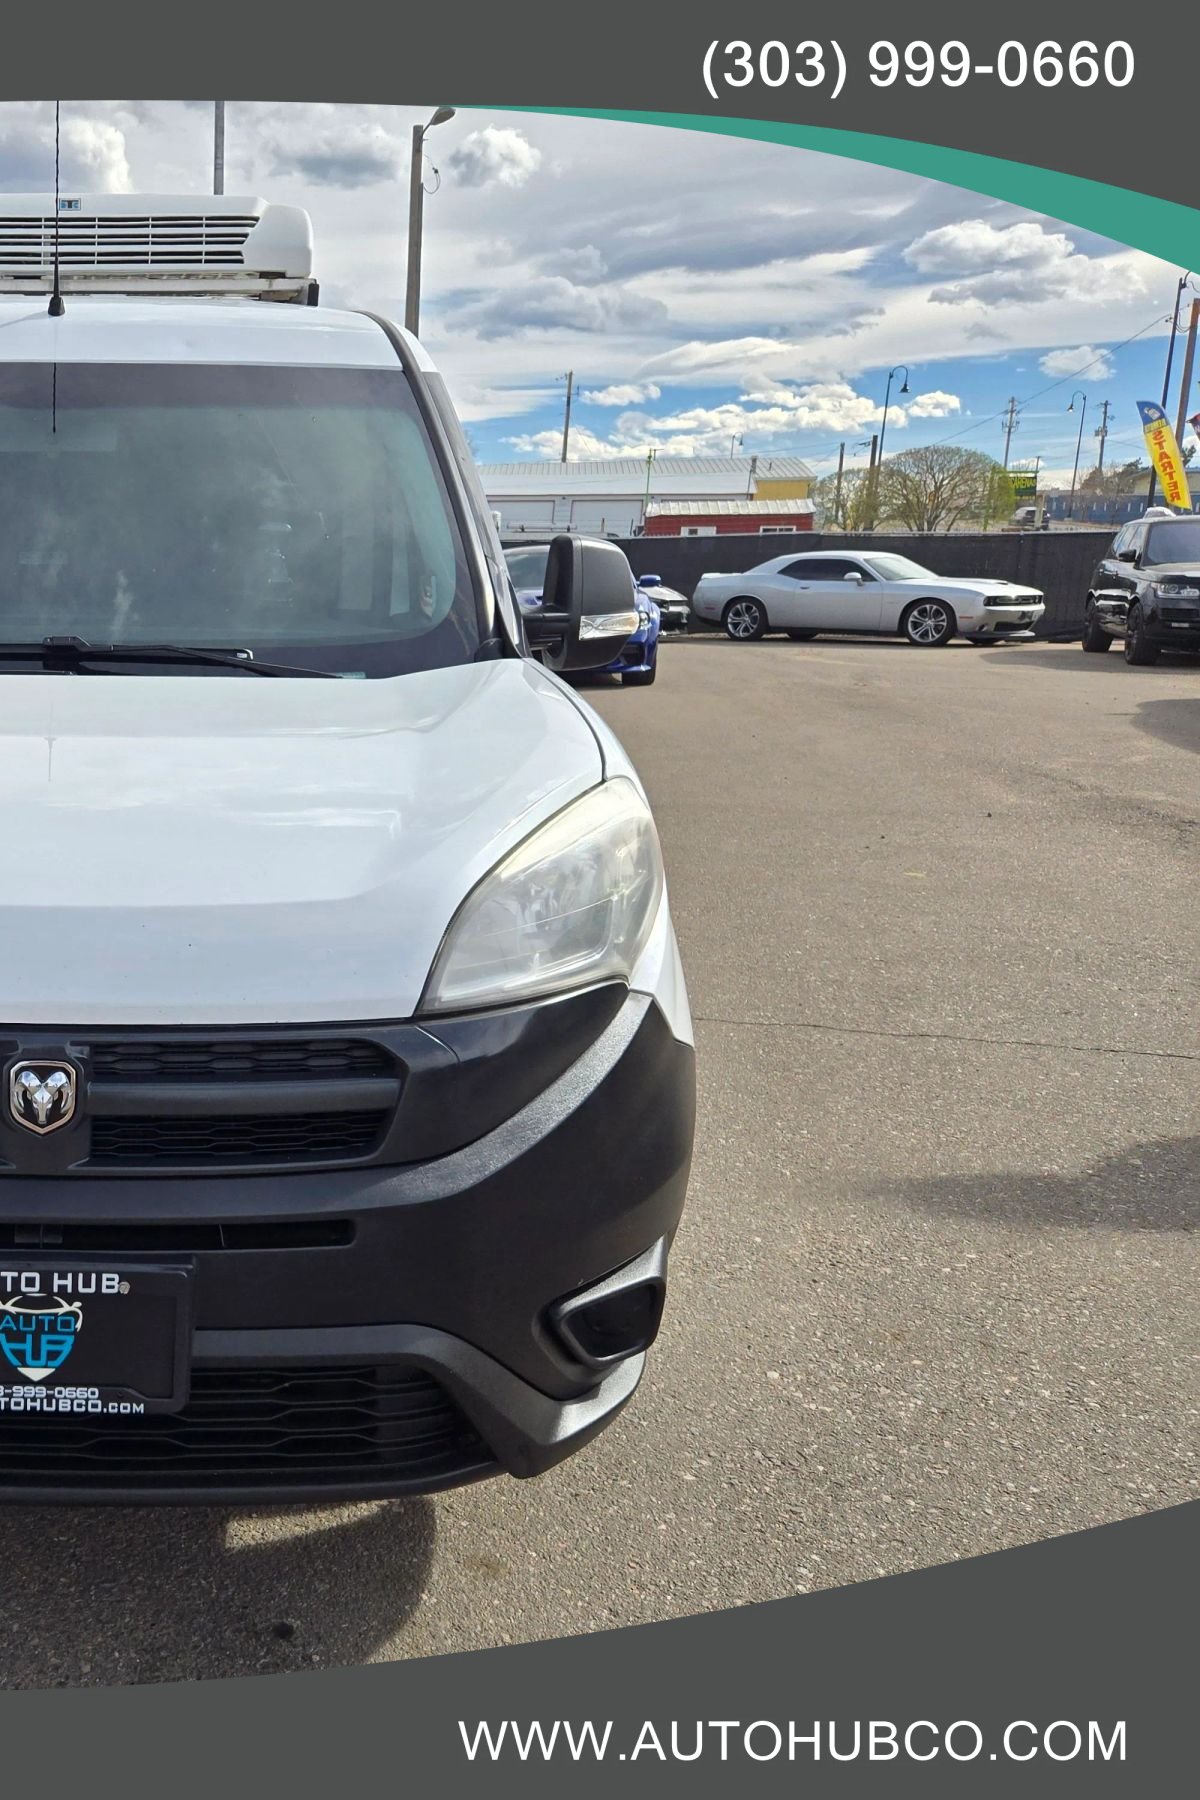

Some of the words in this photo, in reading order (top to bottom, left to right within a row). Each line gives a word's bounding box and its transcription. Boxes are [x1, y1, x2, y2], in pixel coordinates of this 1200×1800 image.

[1152, 430, 1181, 502] STARTER
[53, 1272, 120, 1294] HUB
[0, 1315, 75, 1332] AUTO
[0, 1333, 75, 1368] HUB
